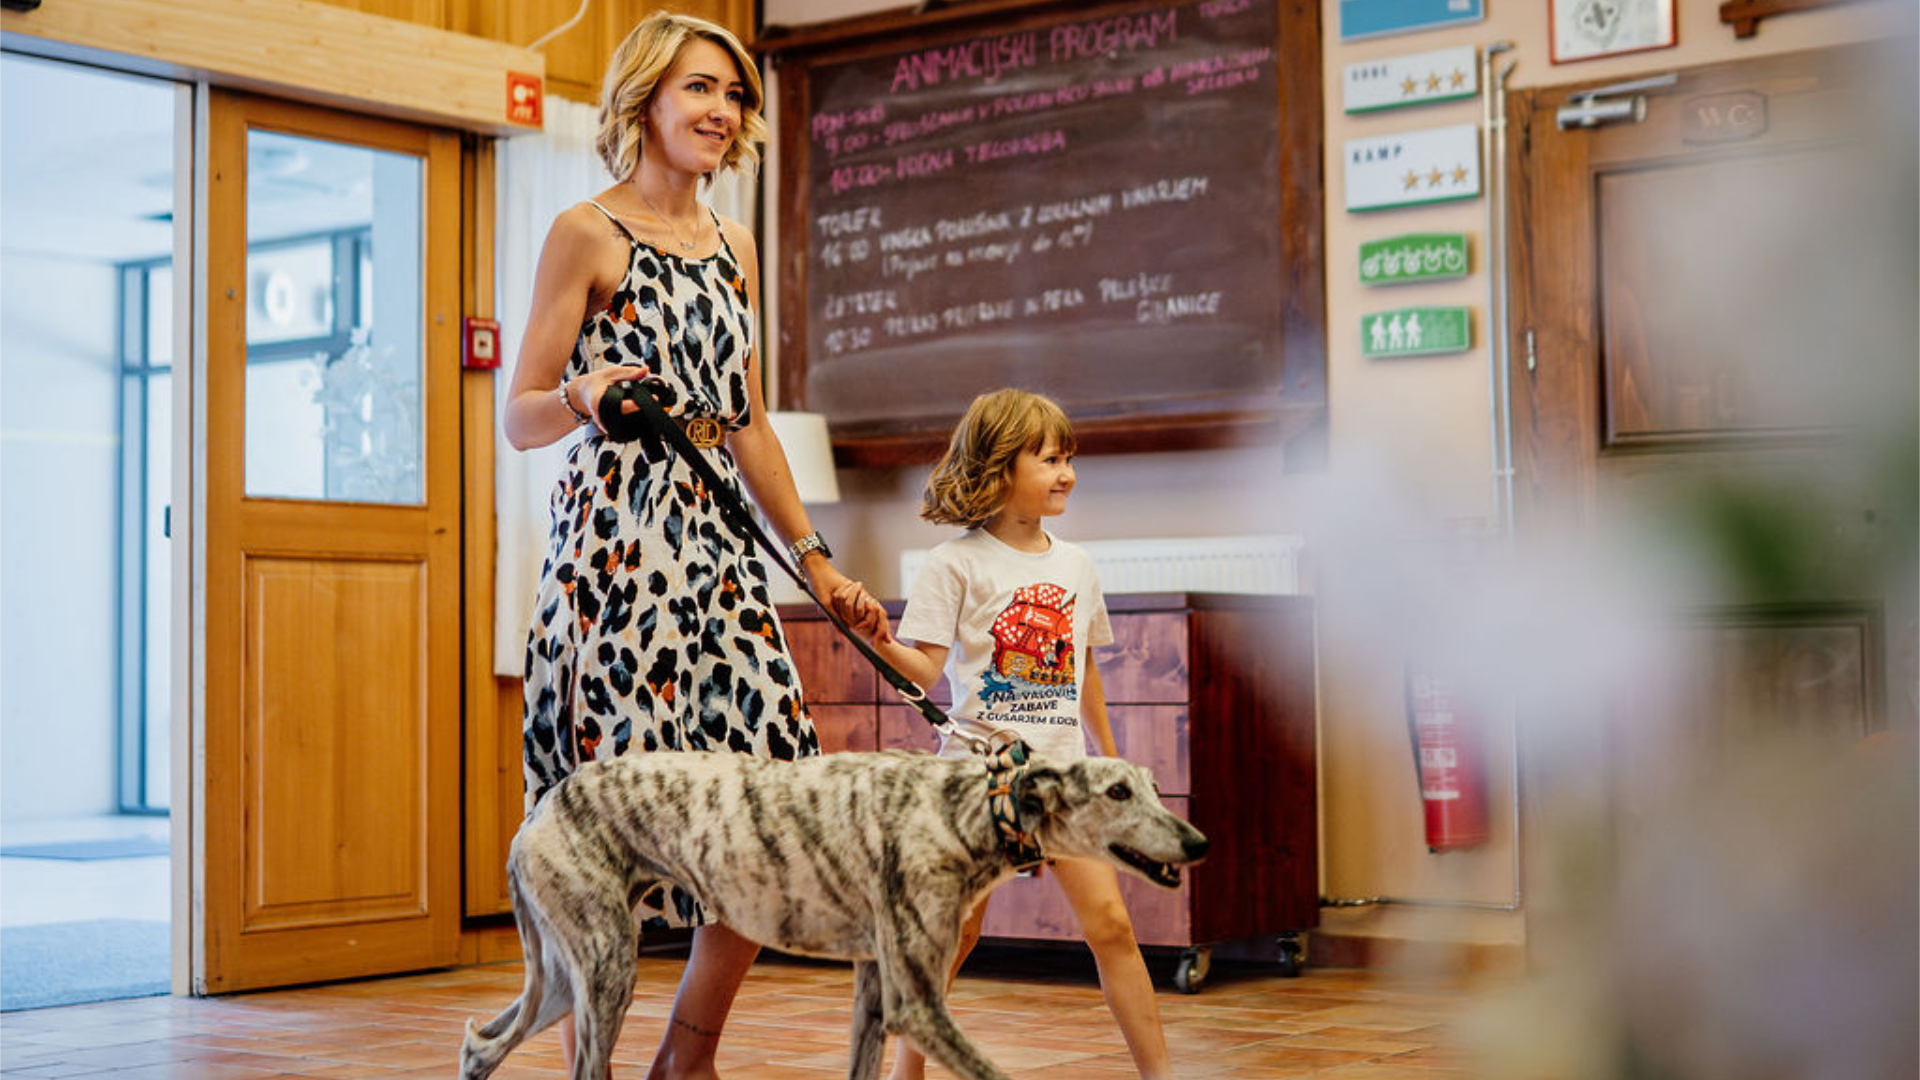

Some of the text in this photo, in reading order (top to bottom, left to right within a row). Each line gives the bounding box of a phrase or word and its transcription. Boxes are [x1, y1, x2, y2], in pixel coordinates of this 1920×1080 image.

[888, 8, 1177, 93] ANIMACIJSKI PROGRAM
[1352, 143, 1402, 164] KAMP
[992, 690, 1016, 704] NA
[1009, 699, 1058, 713] ZABAVE
